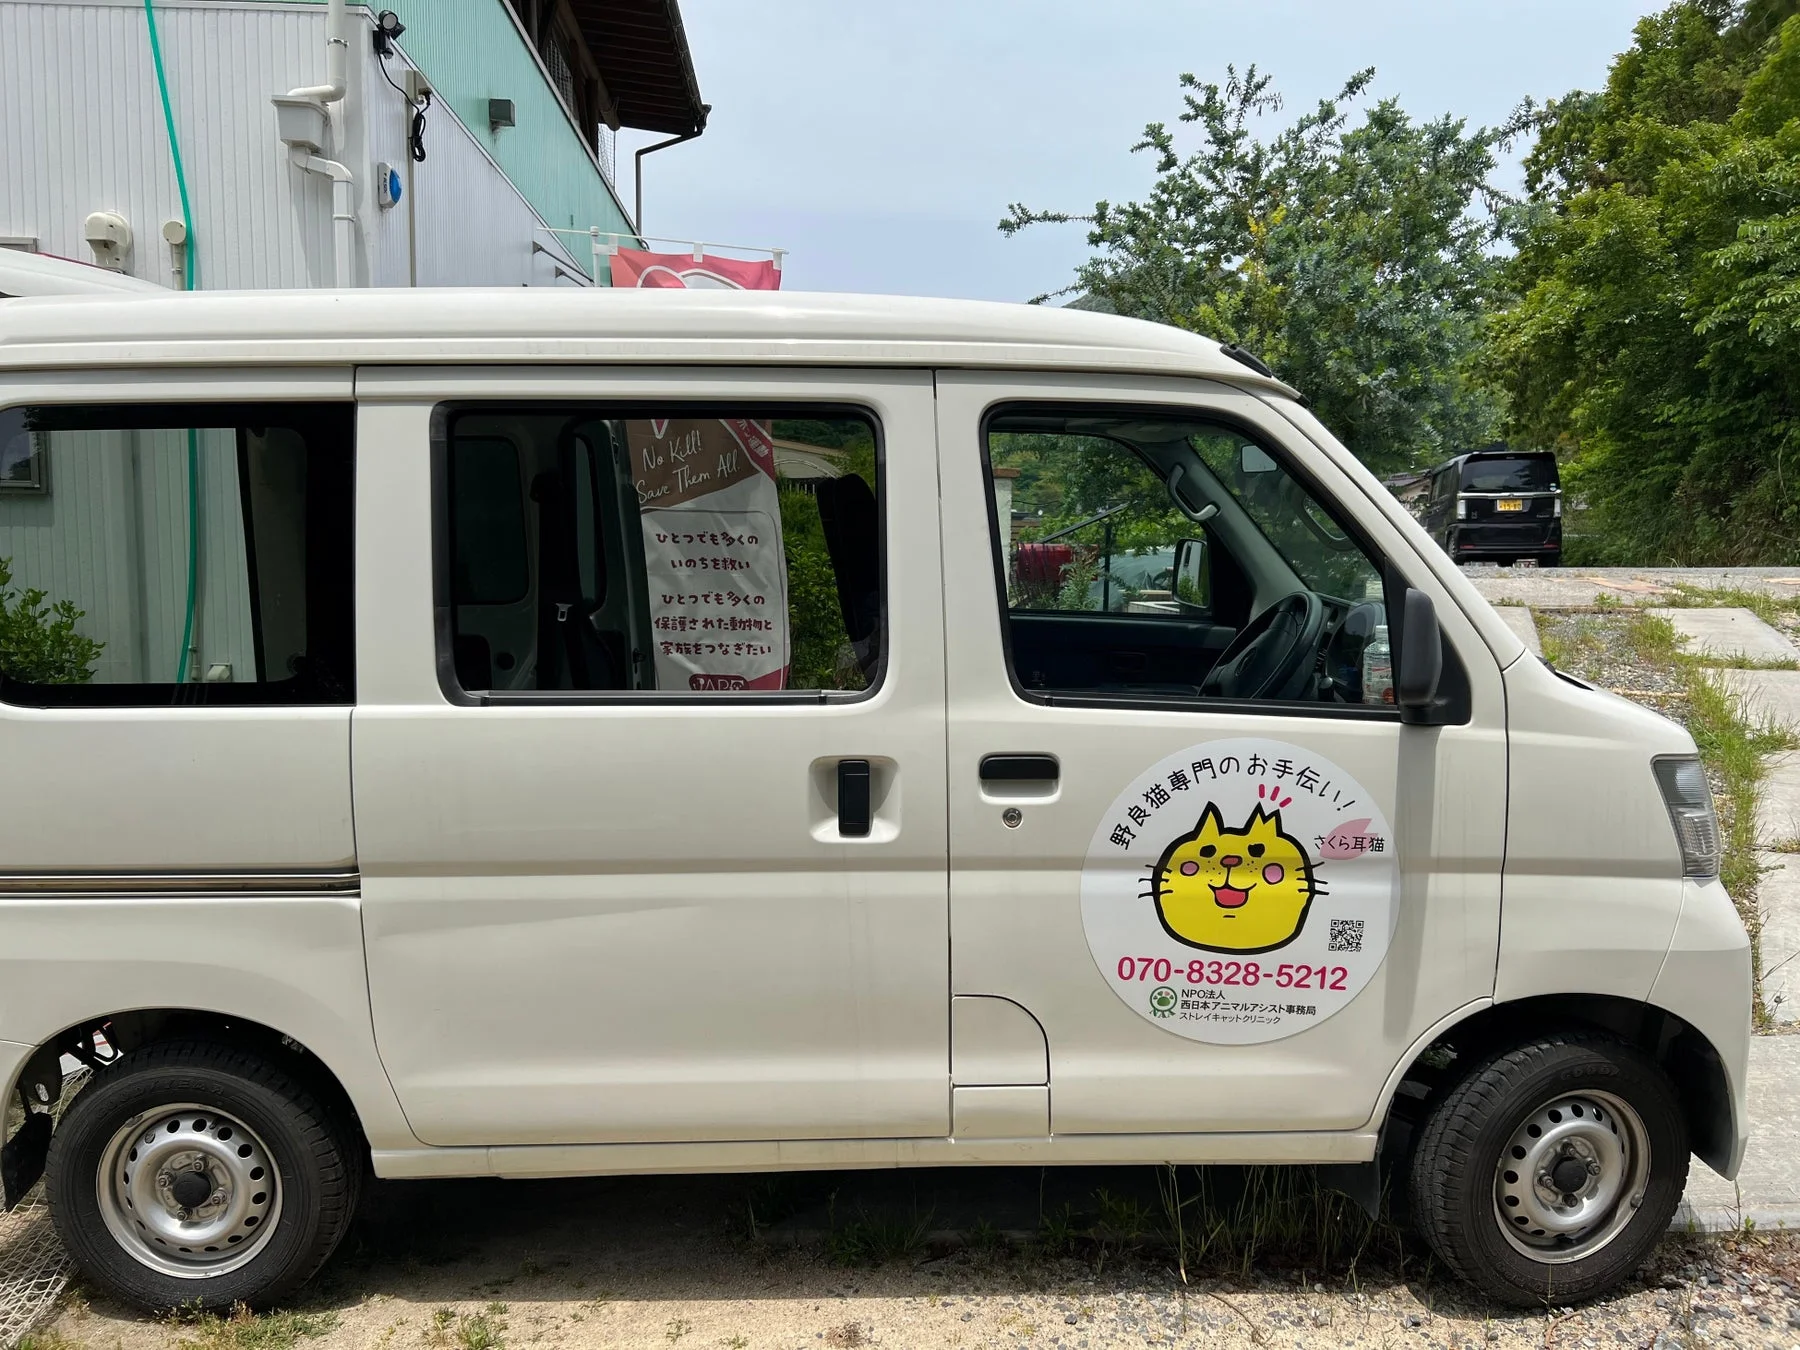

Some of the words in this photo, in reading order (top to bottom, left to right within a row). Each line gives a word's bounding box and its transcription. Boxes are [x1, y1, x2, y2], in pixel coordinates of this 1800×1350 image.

[642, 446, 664, 472] No
[669, 430, 702, 463] Kill!
[636, 479, 670, 504] Save
[672, 464, 711, 493] Them
[656, 531, 759, 547] ひとつでも多くの
[671, 557, 750, 571] いのちを救い
[661, 591, 765, 607] ひとつでも多くの
[654, 616, 773, 632] 保護された動物と
[660, 641, 771, 656] 家族をつなぎたい
[1314, 835, 1385, 852] さくら耳猫
[1117, 956, 1349, 990] 070-8328-5212
[1181, 989, 1225, 1000] NPO法人
[1180, 1000, 1316, 1016] 西日本アニマルアシスト事務局
[1179, 1012, 1281, 1025] ストレイキャットクリニック
